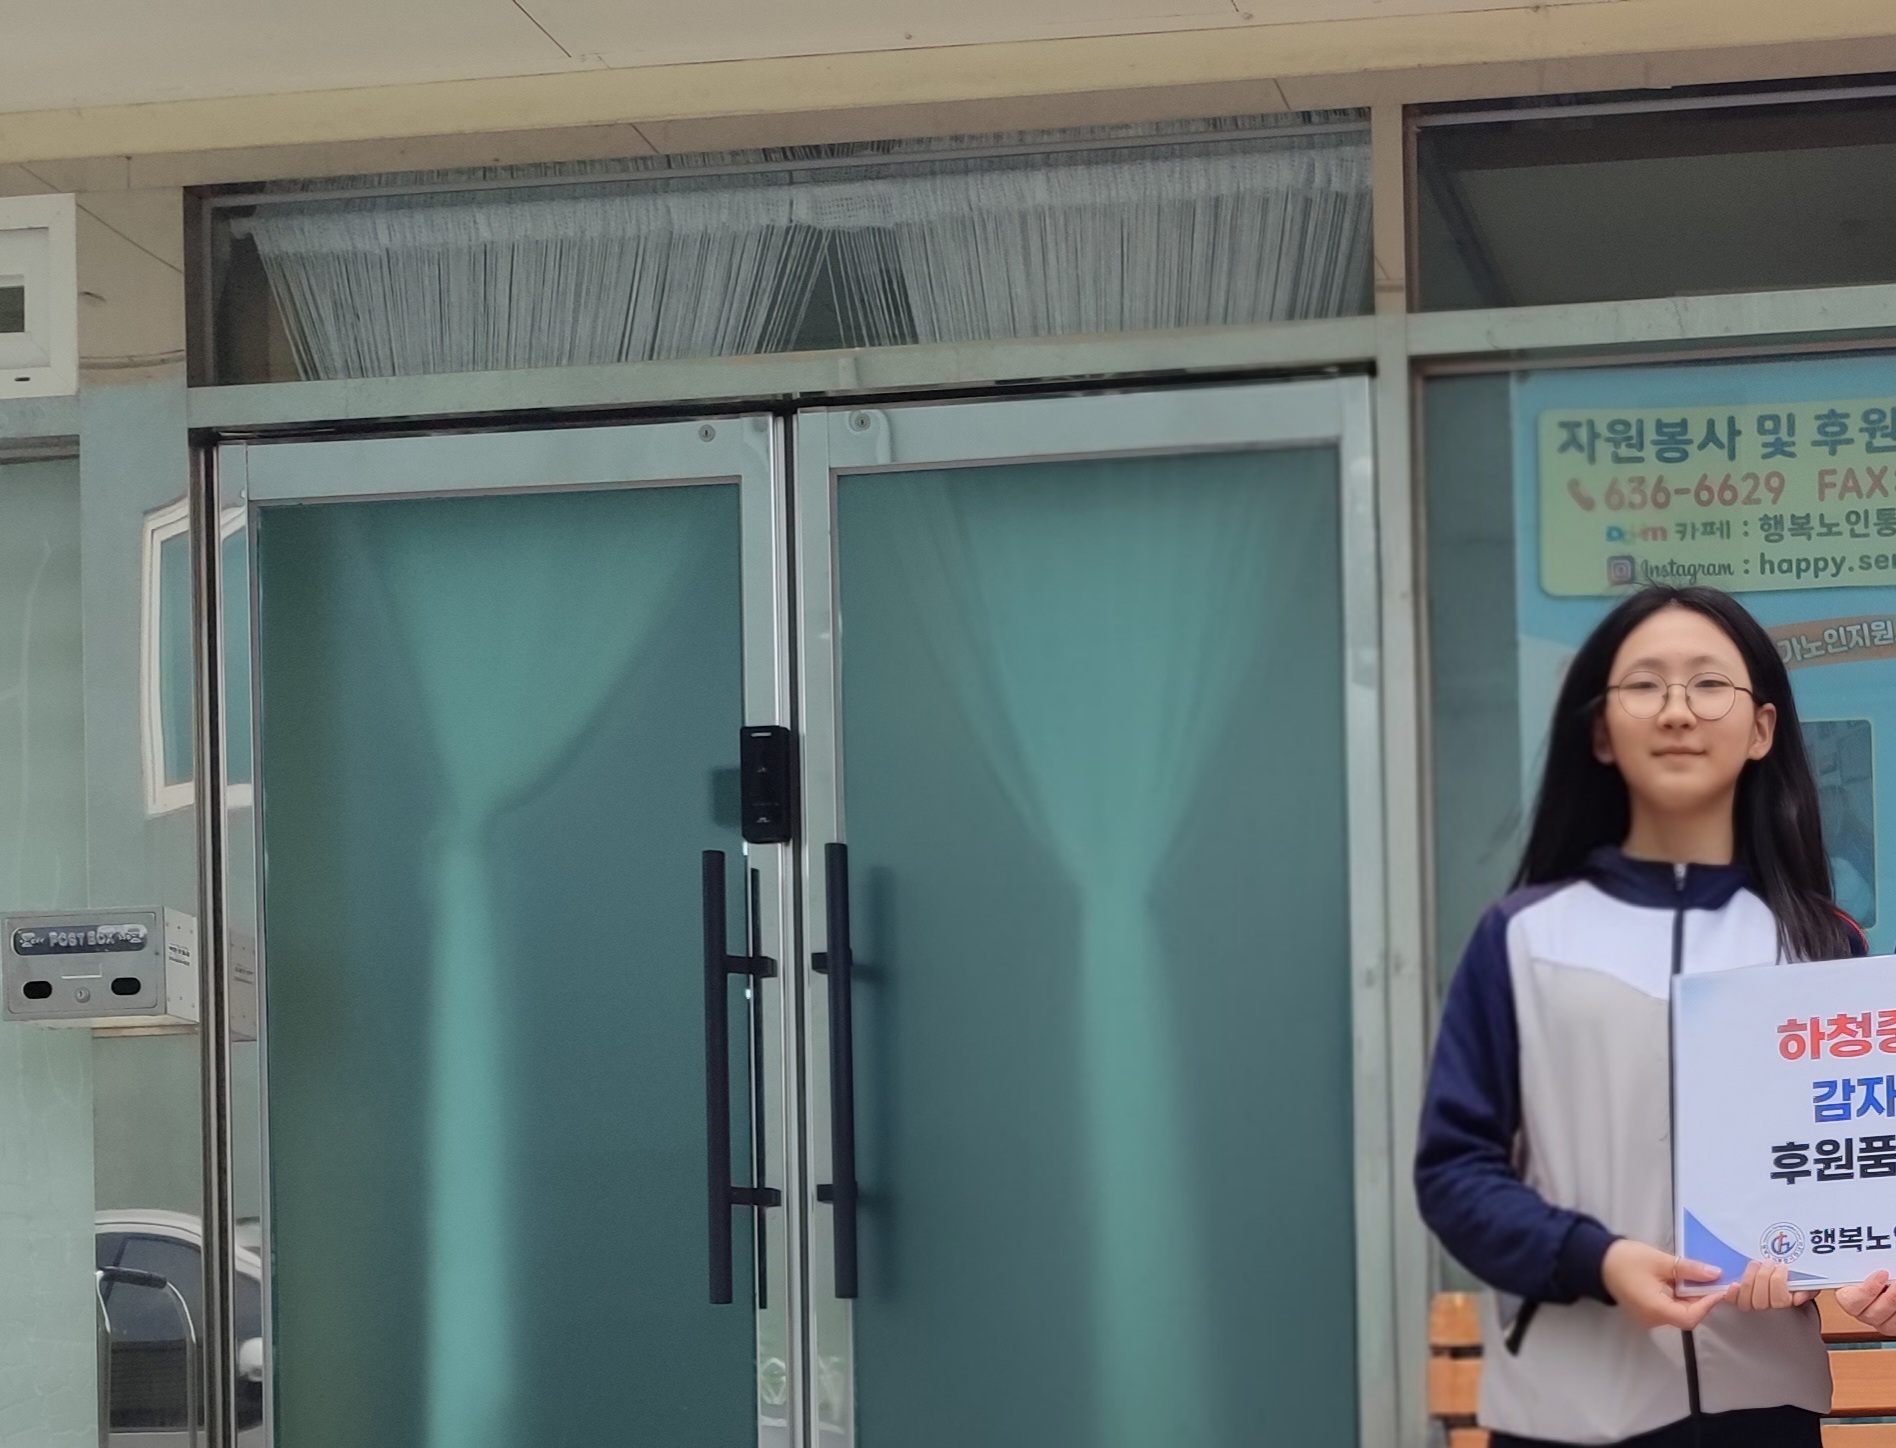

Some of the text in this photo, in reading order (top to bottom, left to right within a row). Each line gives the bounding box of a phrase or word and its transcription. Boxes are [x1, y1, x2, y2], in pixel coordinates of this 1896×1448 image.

[1557, 416, 1742, 466] 자원봉사
[1757, 412, 1798, 460] 및
[1604, 470, 1785, 512] 636-6629
[1674, 519, 1731, 542] 카페
[1641, 557, 1735, 586] Instagram
[49, 930, 115, 947] POST BOX
